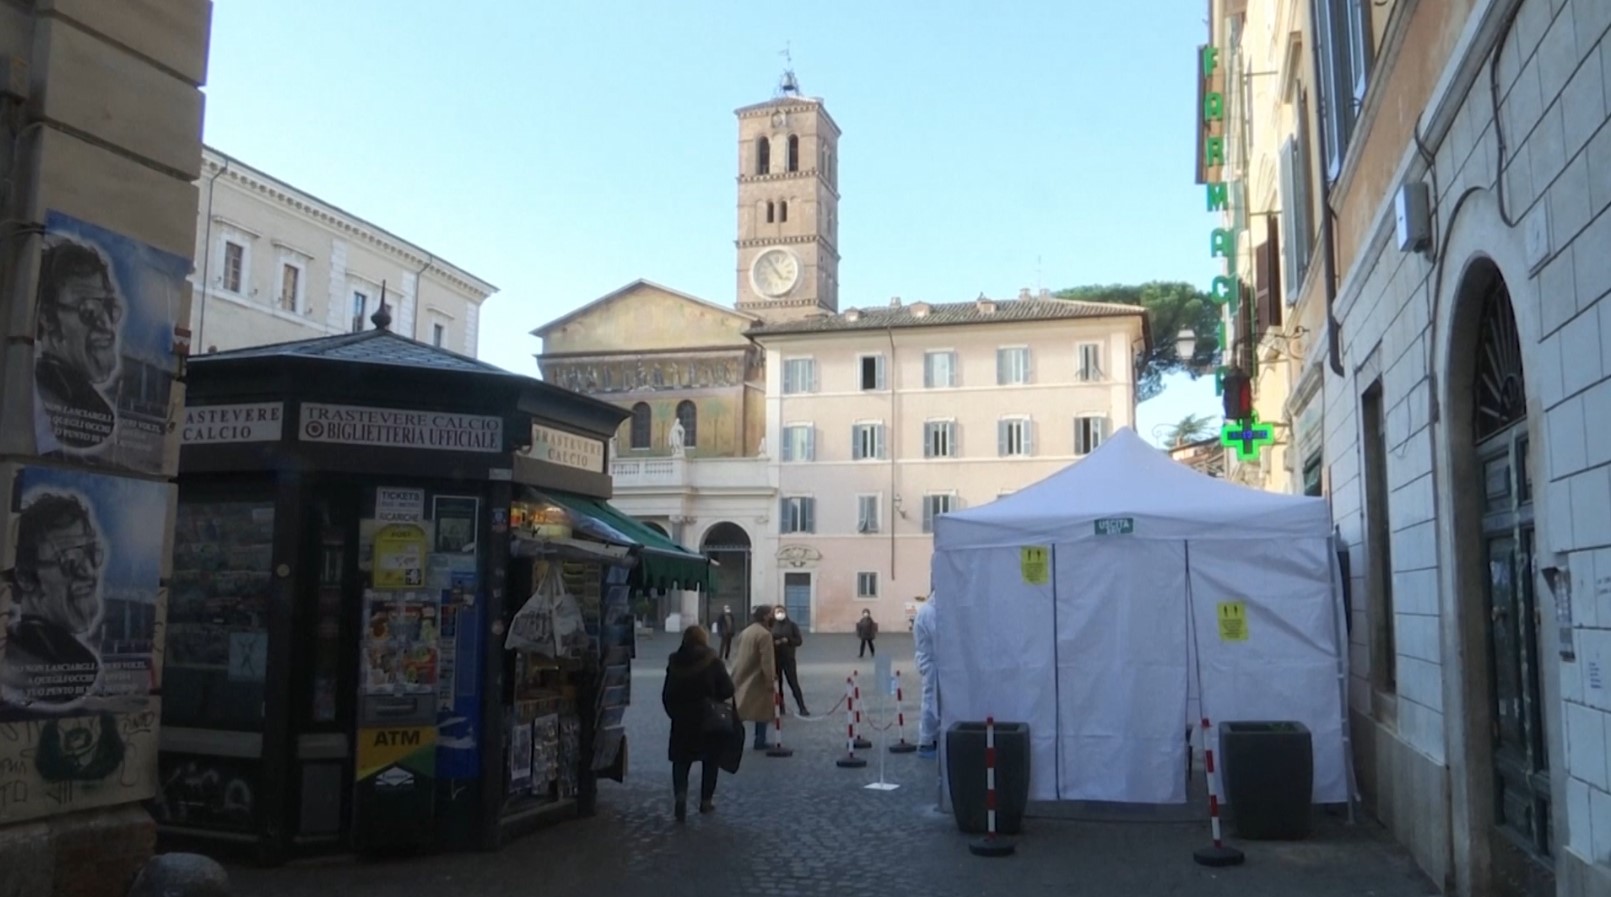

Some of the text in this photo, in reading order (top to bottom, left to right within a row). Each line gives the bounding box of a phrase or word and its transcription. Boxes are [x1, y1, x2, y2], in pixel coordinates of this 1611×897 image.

[185, 408, 280, 425] ASTEVERE
[306, 407, 500, 432] TRASTEVERE CALCIO
[183, 426, 252, 441] CALCIO
[327, 421, 498, 449] BIGLIETTERIA UFFICIALE
[535, 429, 602, 456] TRASTEVERE
[548, 448, 588, 467] CALCIO
[382, 491, 420, 501] TICKETS
[1098, 519, 1131, 530] USCITA
[374, 730, 421, 747] ATM
